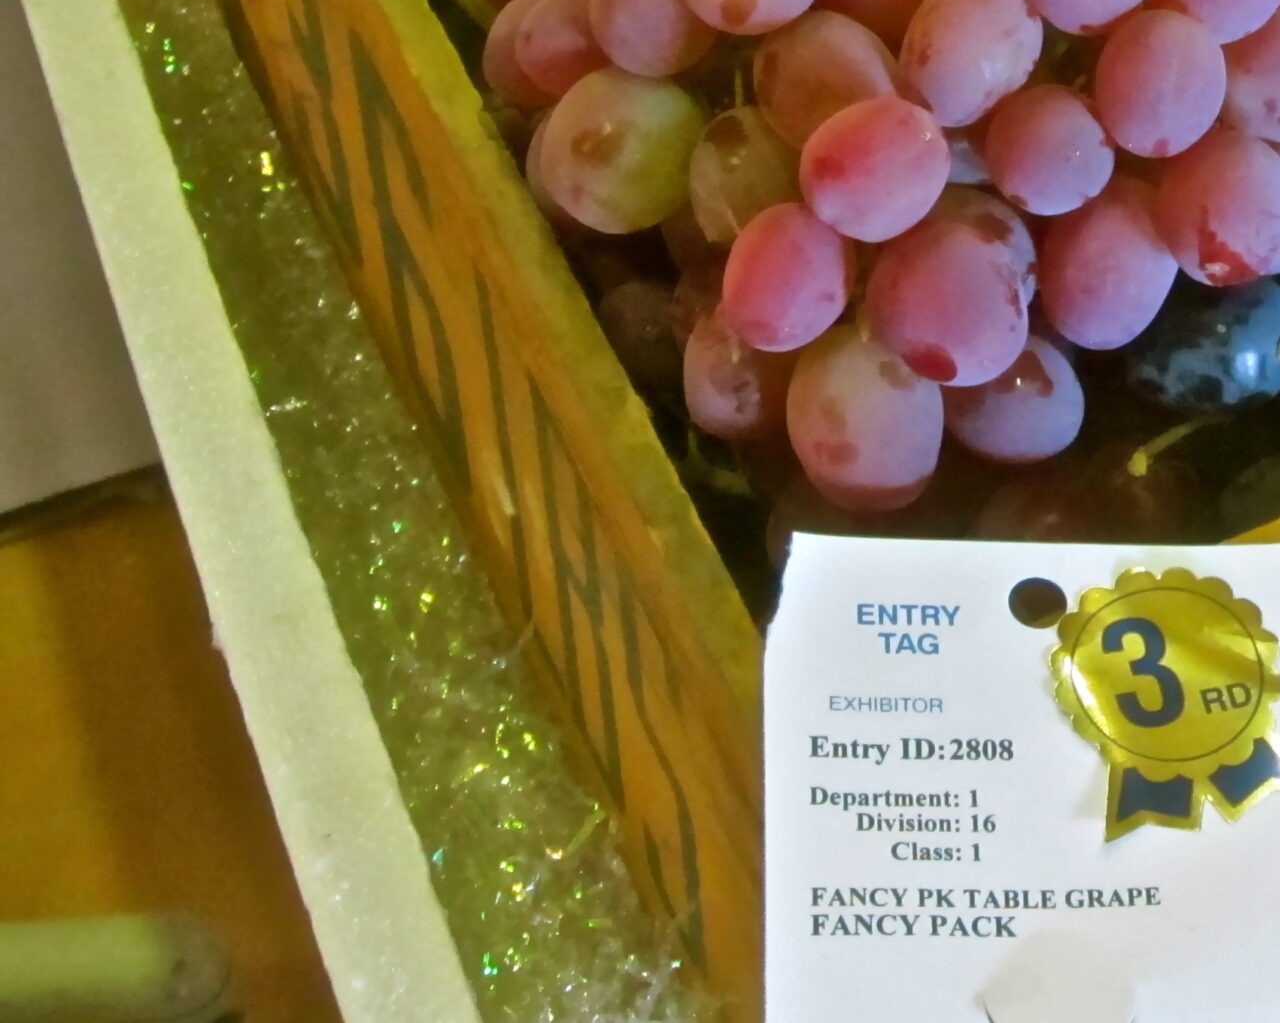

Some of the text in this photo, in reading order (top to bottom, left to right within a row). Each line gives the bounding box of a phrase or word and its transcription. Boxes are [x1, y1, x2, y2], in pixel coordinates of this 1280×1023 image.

[856, 603, 961, 626] ENTRY
[878, 633, 941, 655] TAG
[1101, 617, 1254, 728] 3 RD
[828, 695, 944, 713] EXHIBITOR
[809, 736, 1014, 764] Entry ID:2808
[809, 787, 979, 812] Department: 1
[856, 813, 997, 833] Division: 16
[890, 842, 982, 862] Class: 1
[810, 887, 1161, 909] FANCY PK TABLE GRAPE
[810, 914, 1017, 938] FANCY PACK
